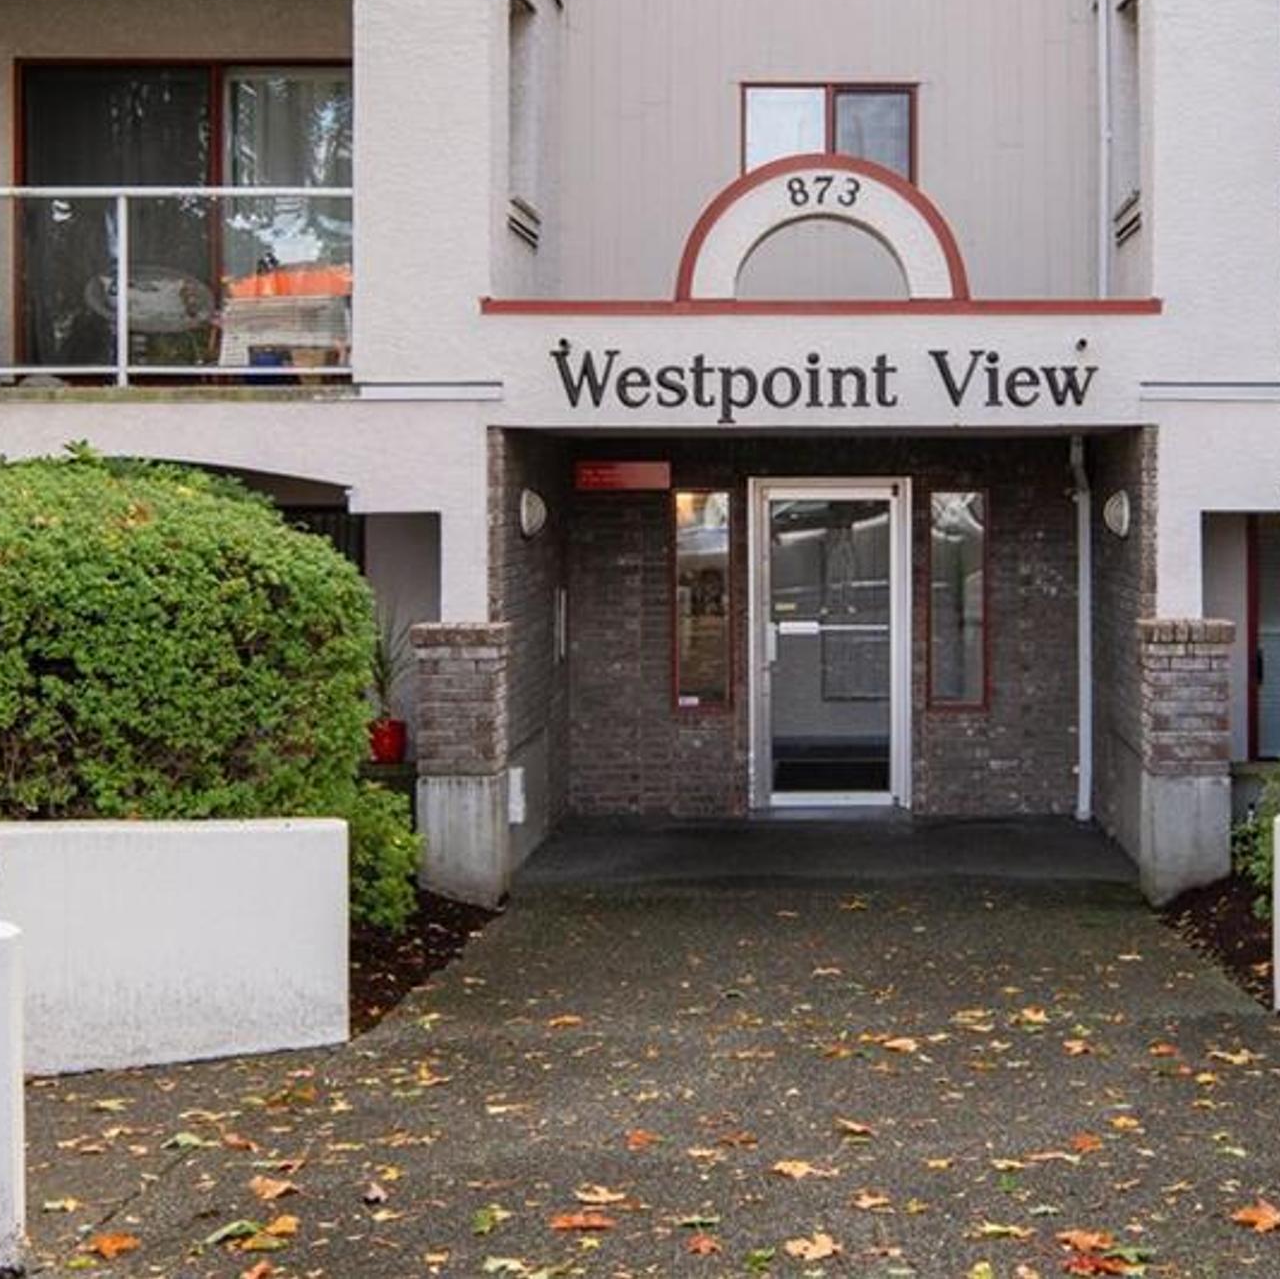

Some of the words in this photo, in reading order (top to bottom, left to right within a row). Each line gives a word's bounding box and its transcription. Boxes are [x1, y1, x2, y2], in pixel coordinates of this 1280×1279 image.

[787, 176, 861, 206] 873
[551, 349, 898, 424] Westpoint
[929, 350, 1099, 408] View
